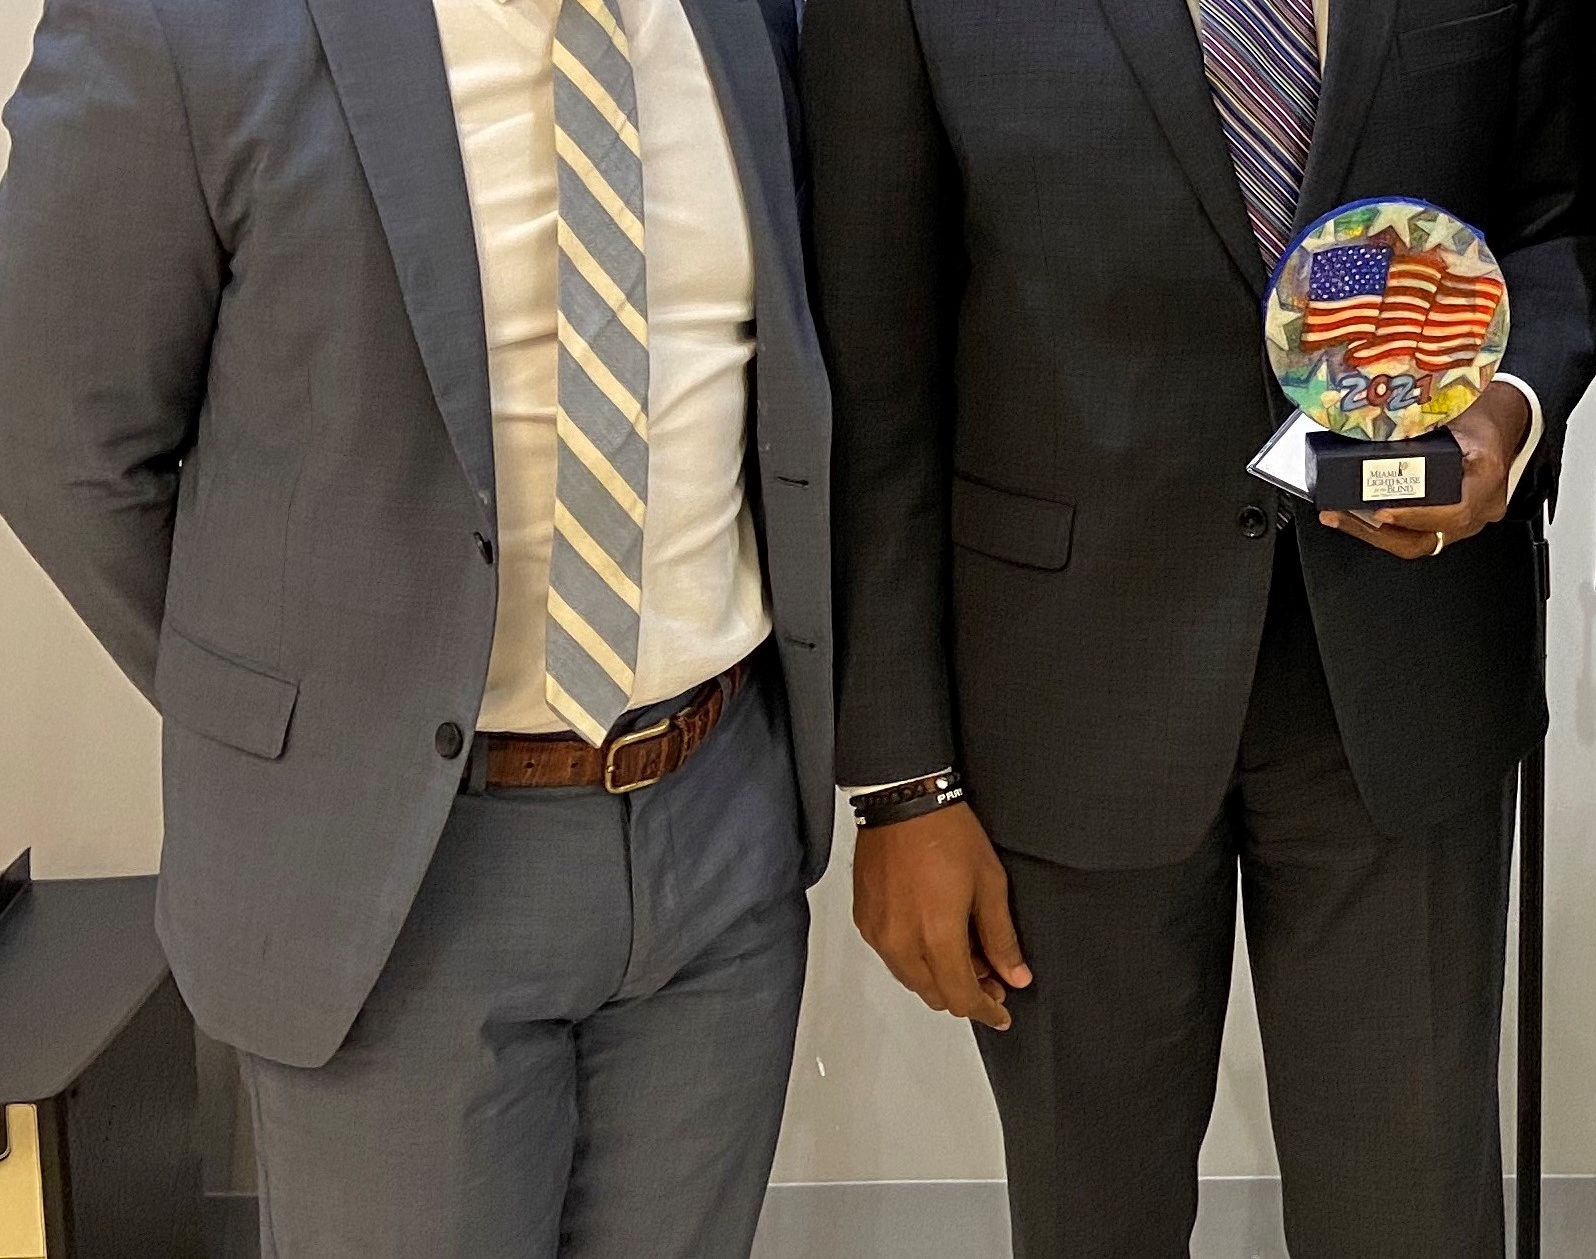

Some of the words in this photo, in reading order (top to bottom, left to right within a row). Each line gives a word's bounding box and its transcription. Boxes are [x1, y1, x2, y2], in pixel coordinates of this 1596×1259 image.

[1339, 374, 1433, 412] 2021
[1370, 470, 1397, 479] MIAMI
[1367, 477, 1421, 486] LIGHTHOUSE
[1387, 484, 1414, 493] BLIND
